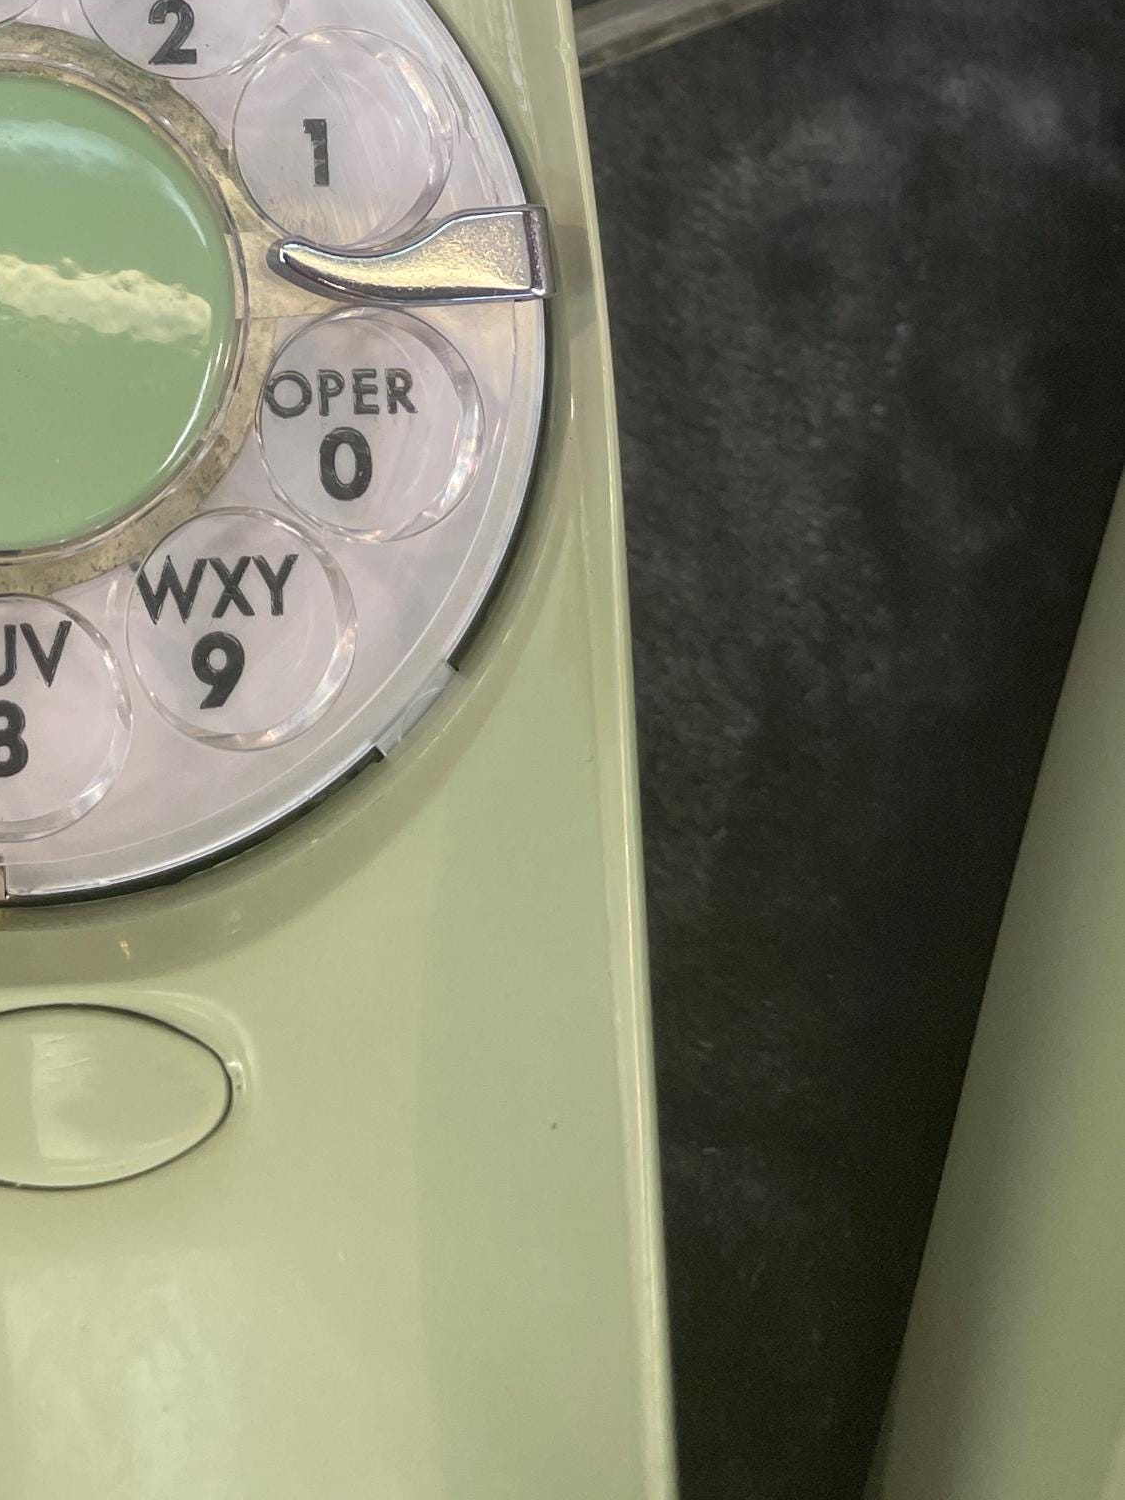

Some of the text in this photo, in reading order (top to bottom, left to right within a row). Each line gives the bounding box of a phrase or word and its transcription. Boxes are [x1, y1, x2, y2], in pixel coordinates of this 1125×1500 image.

[302, 118, 331, 187] 1
[263, 367, 418, 419] OPER
[318, 426, 373, 501] 0
[130, 553, 299, 625] WXY
[191, 631, 245, 710] 9
